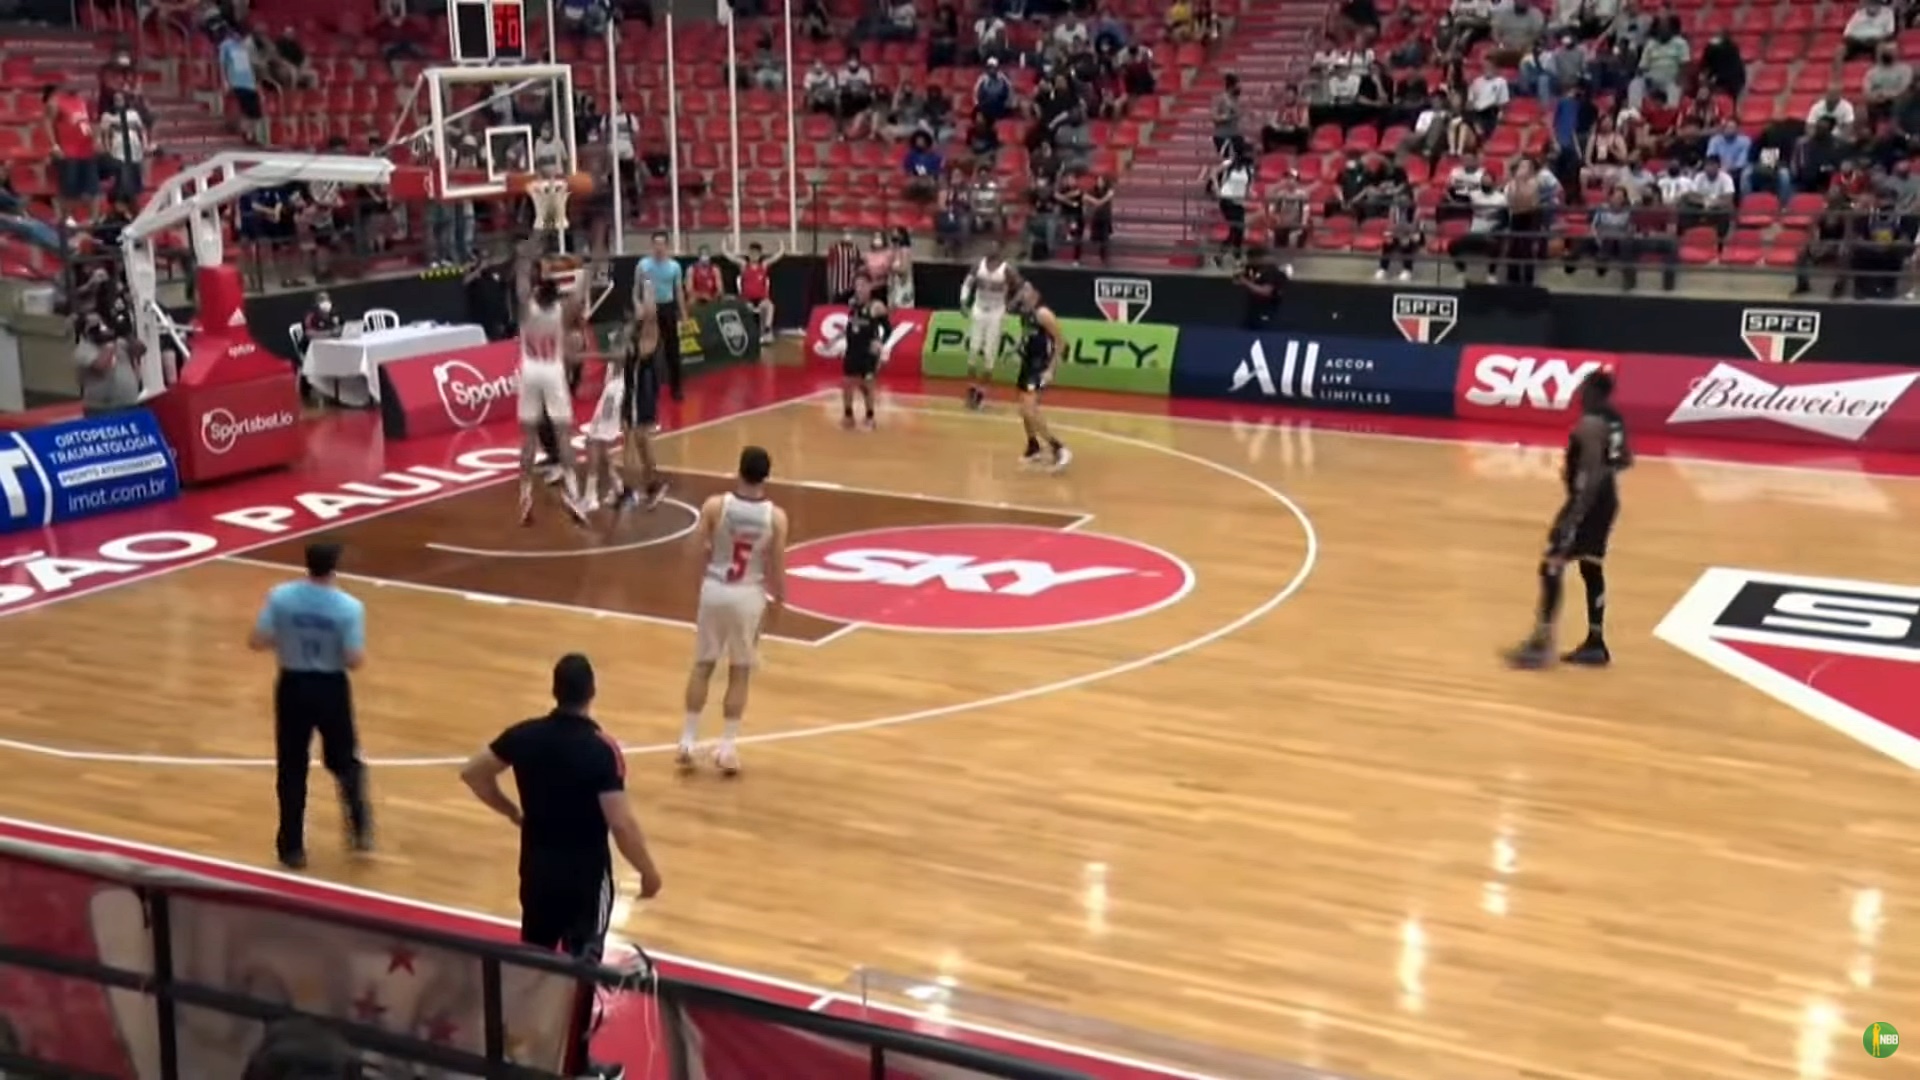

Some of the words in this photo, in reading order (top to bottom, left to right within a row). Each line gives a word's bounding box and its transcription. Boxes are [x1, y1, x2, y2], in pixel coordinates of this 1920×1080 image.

[1400, 300, 1451, 316] SPFC
[1749, 315, 1812, 332] SPFC
[813, 312, 914, 358] SY
[1321, 374, 1352, 384] LIVE
[1325, 358, 1374, 369] ACCOR
[1320, 390, 1391, 404] LIMITLESS
[1465, 354, 1601, 410] SKY
[1688, 376, 1887, 417] Budweiser
[55, 425, 128, 448] ORTOPEDIA
[130, 423, 139, 435] E
[210, 410, 293, 441] Sportsbet.io
[48, 434, 157, 465] TRAUMATOLOGIA
[69, 477, 167, 512] imot.com.br
[212, 448, 548, 533] PAULO
[726, 540, 753, 583] 5
[785, 549, 1137, 596] SKY
